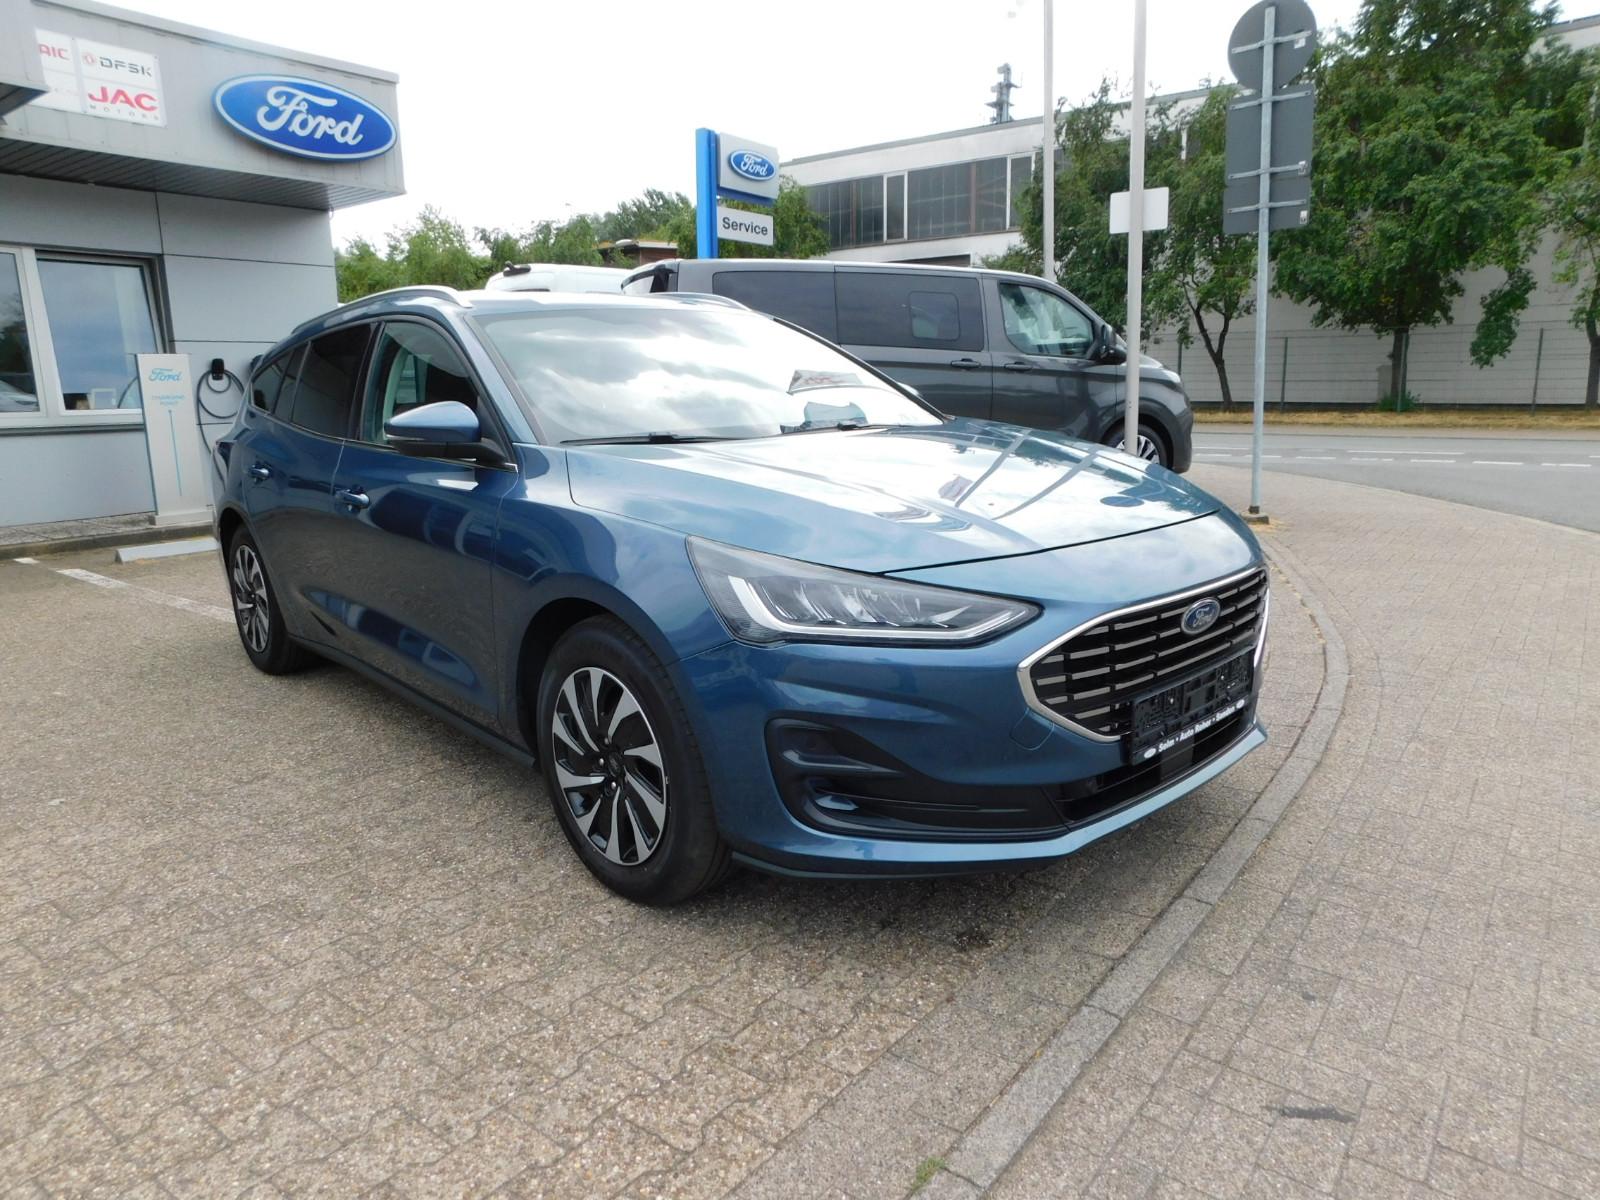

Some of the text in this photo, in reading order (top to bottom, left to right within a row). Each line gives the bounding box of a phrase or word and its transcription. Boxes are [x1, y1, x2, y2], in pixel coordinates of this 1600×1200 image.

[99, 55, 153, 78] DFSK
[88, 86, 159, 112] JAC
[257, 86, 364, 145] Ford
[741, 154, 767, 176] Ford
[722, 217, 768, 236] Service
[149, 368, 183, 382] Ford
